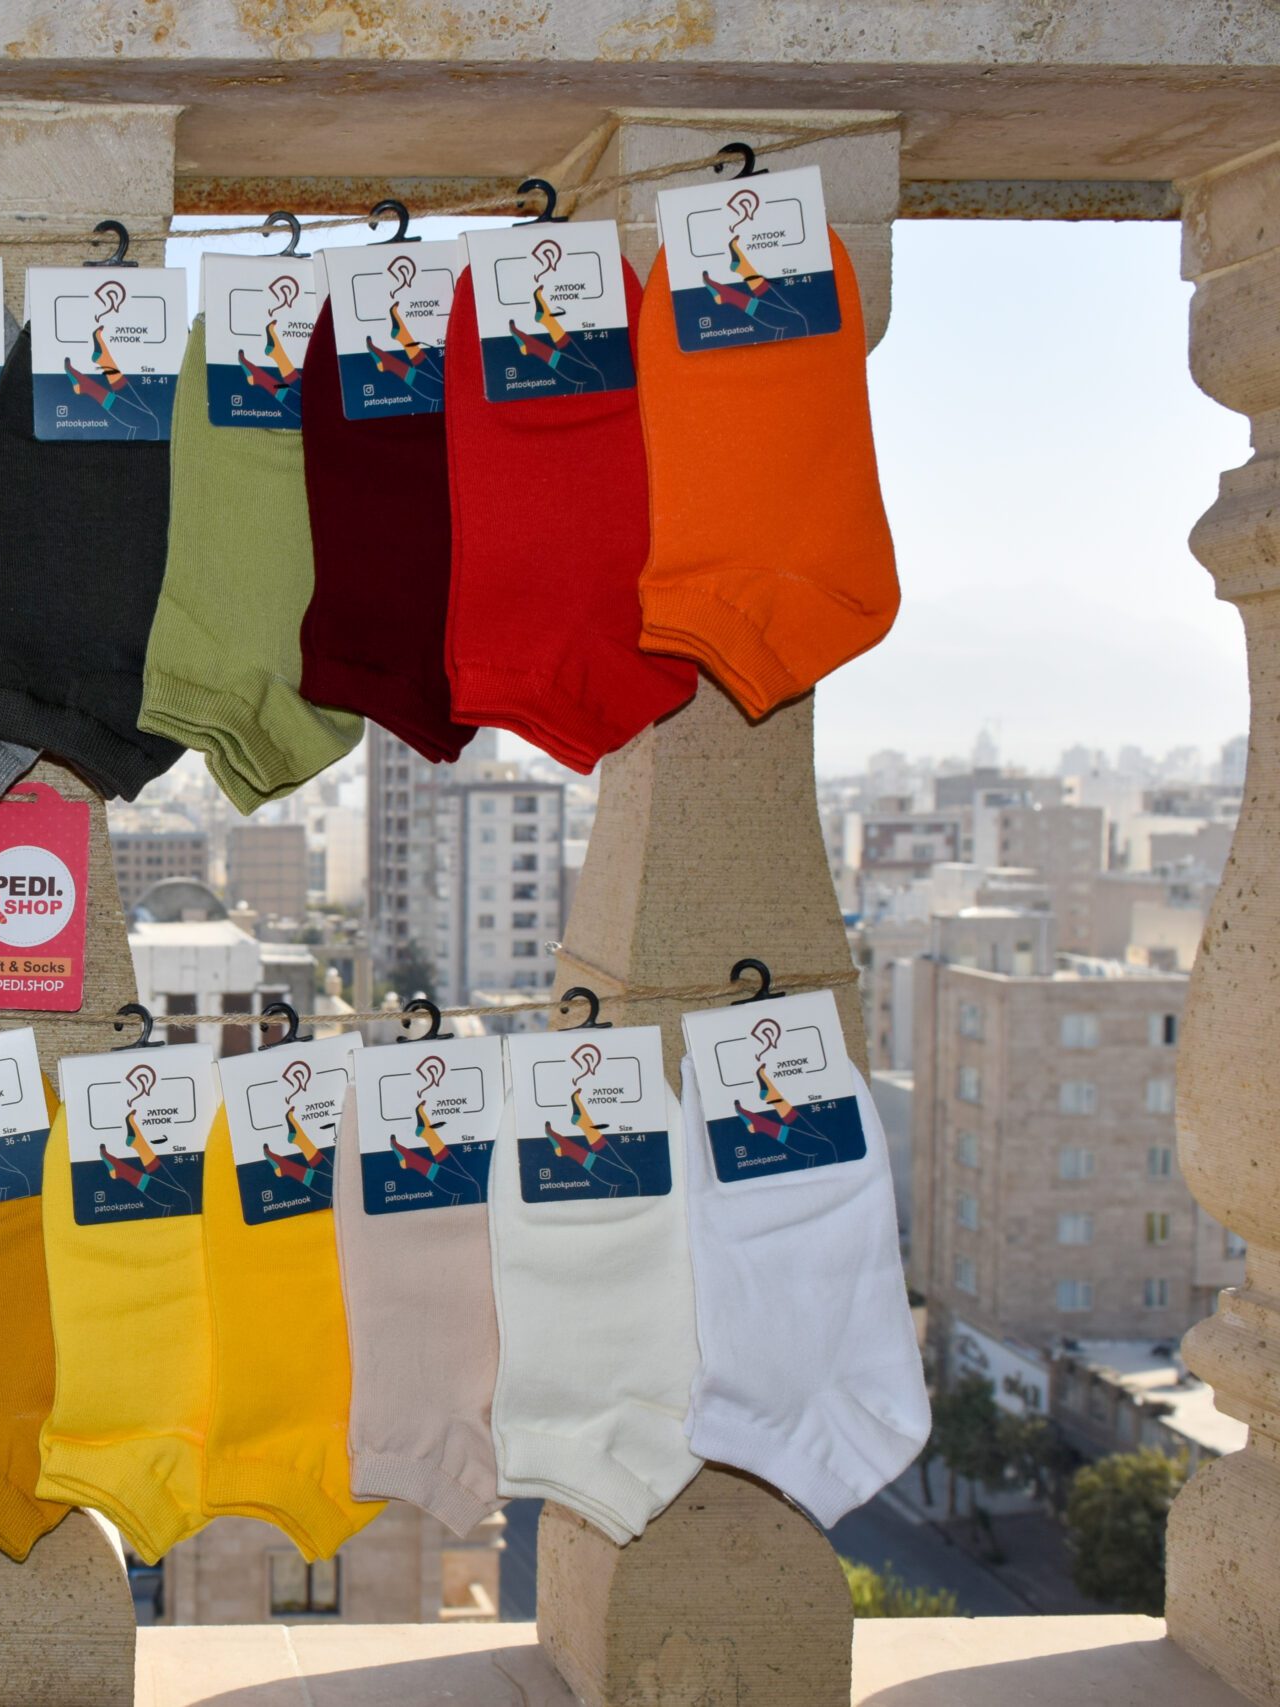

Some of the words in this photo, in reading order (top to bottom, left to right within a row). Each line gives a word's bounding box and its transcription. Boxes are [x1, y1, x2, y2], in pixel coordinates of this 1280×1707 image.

[752, 231, 786, 241] PATOOK
[746, 241, 779, 250] PATOOK
[555, 283, 586, 292] PATOOK
[410, 300, 440, 308] PATOOK
[700, 325, 754, 339] patookpatook
[506, 379, 556, 390] patookpatook
[364, 396, 412, 407] patookpatook
[232, 409, 282, 417] patookpatook
[56, 420, 108, 428] patookpatook
[4, 900, 62, 915] SHOP
[8, 961, 19, 972] &
[23, 961, 65, 973] Socks
[777, 1058, 809, 1069] PATOOK
[773, 1068, 803, 1078] PATOOK
[306, 1100, 335, 1111] PATOOK
[437, 1098, 468, 1106] PATOOK
[147, 1108, 178, 1116] PATOOK
[432, 1107, 461, 1116] PATOOK
[811, 1104, 820, 1112] 36
[301, 1110, 330, 1120] PATOOK
[737, 1153, 787, 1168] patookpatook
[540, 1180, 590, 1191] patookpatook
[385, 1191, 433, 1203] patookpatook
[95, 1202, 144, 1213] patookpatook
[263, 1196, 310, 1212] patookpatook
